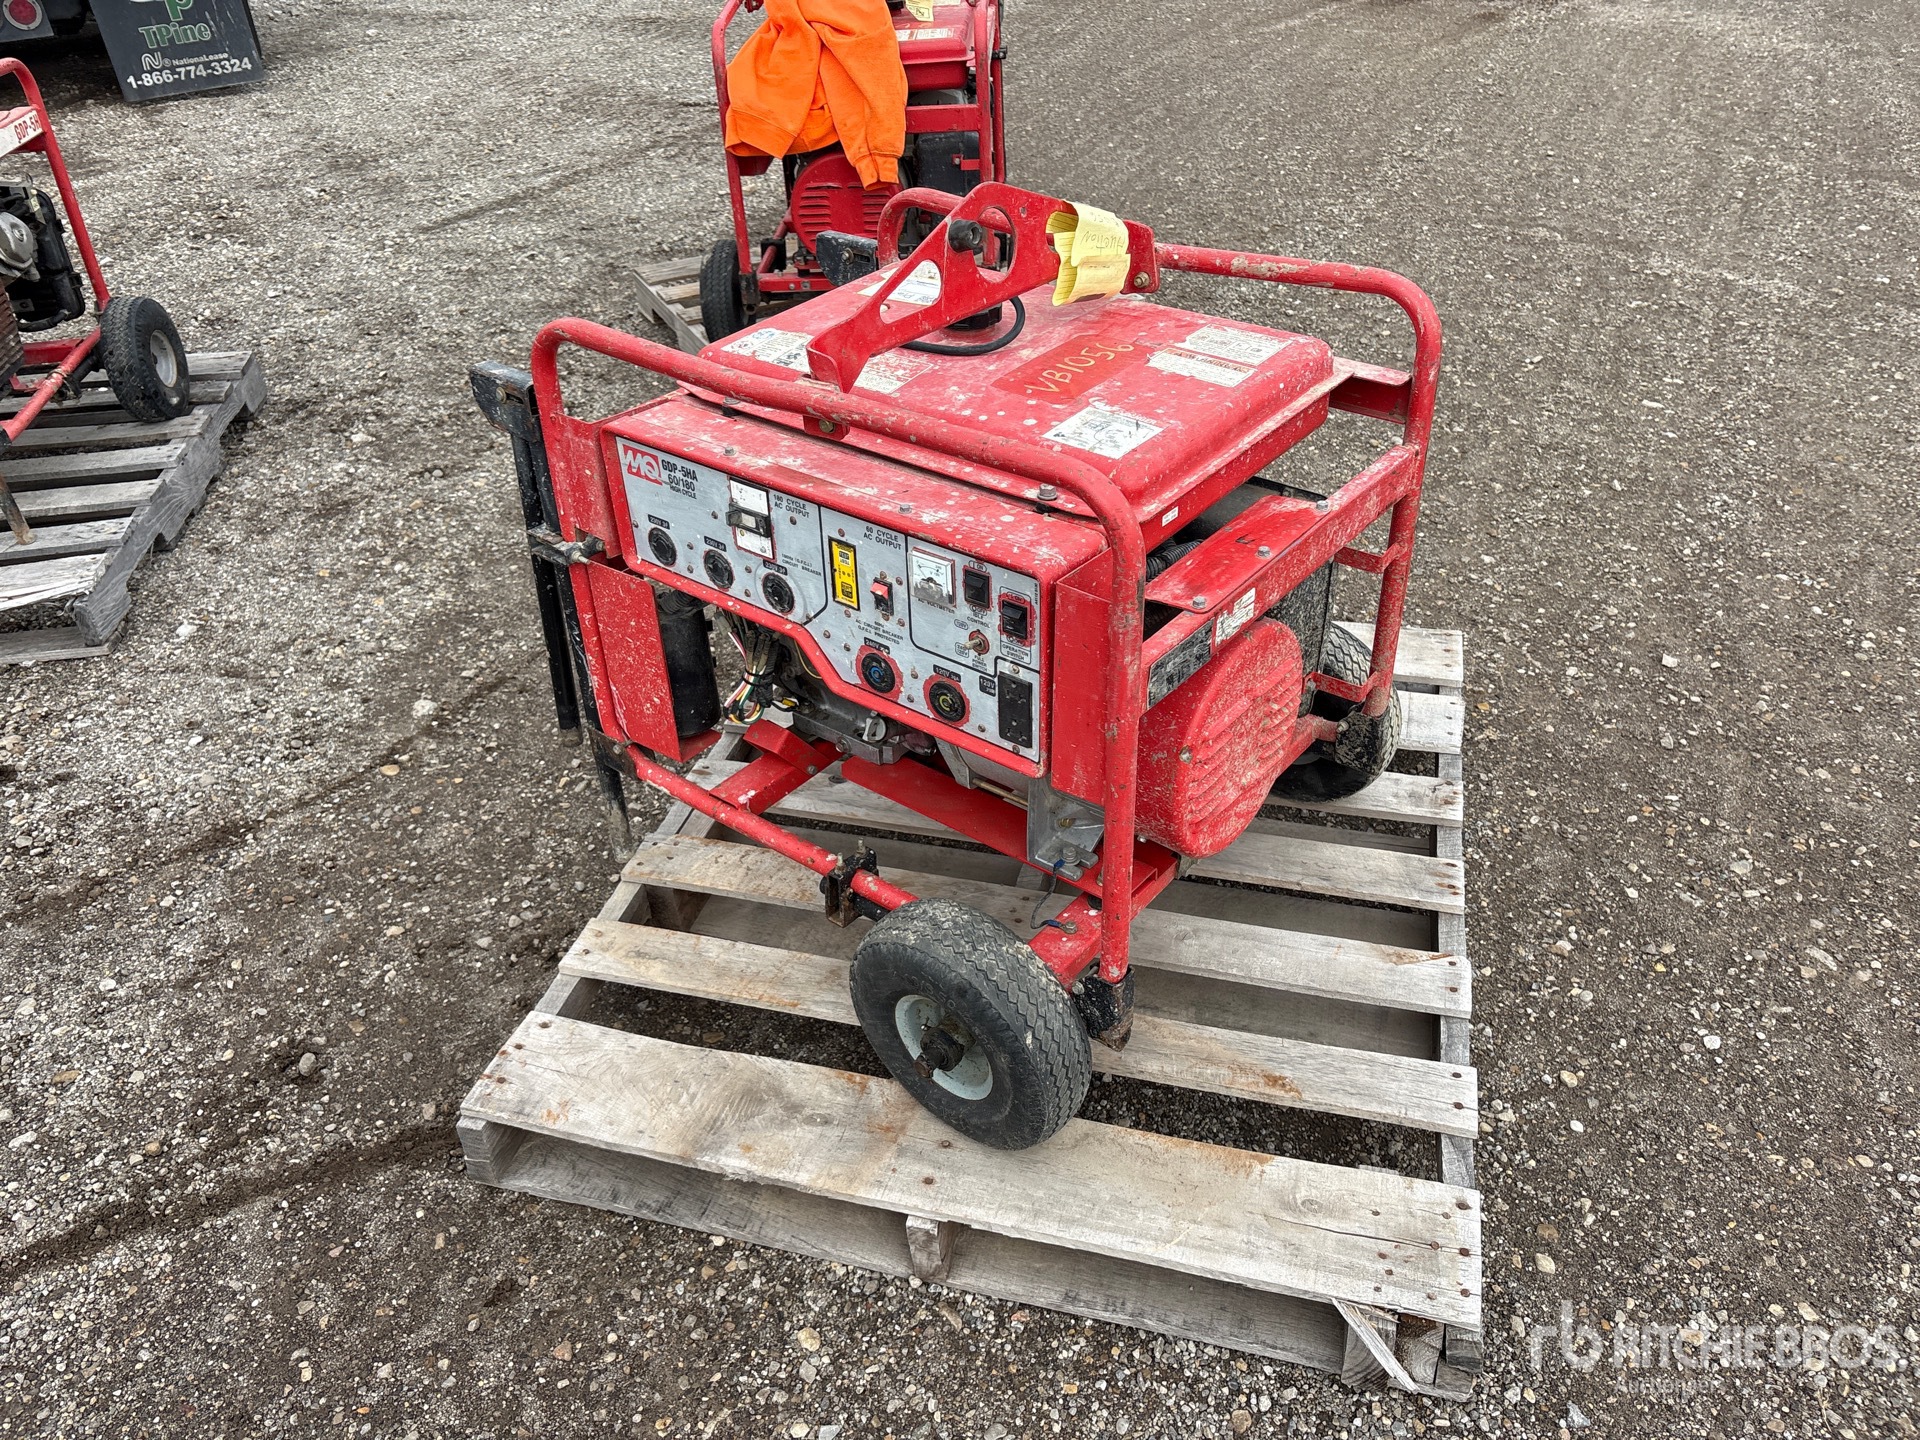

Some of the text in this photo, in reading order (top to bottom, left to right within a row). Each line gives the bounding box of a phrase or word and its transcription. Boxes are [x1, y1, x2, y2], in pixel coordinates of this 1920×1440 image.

[138, 21, 212, 49] TPine
[126, 57, 253, 90] 1-866-774-3324
[1023, 342, 1135, 393] VB1056
[661, 459, 699, 483] GDP-5HA
[667, 473, 697, 492] 60/180
[682, 489, 698, 500] CYCLE
[773, 493, 807, 511] 180 CYCLE
[774, 502, 810, 518] AC OUTPUT
[863, 532, 902, 551] AC OUTPUT
[865, 525, 899, 543] 60 CYCLE
[801, 565, 822, 577] BREAKER
[863, 621, 881, 632] CIRCUIT
[882, 628, 904, 641] BREAKER
[967, 616, 991, 629] CONTROL
[874, 631, 900, 645] PROTECTED
[1001, 643, 1029, 658] OPERATION
[1006, 650, 1025, 661] SWITCH
